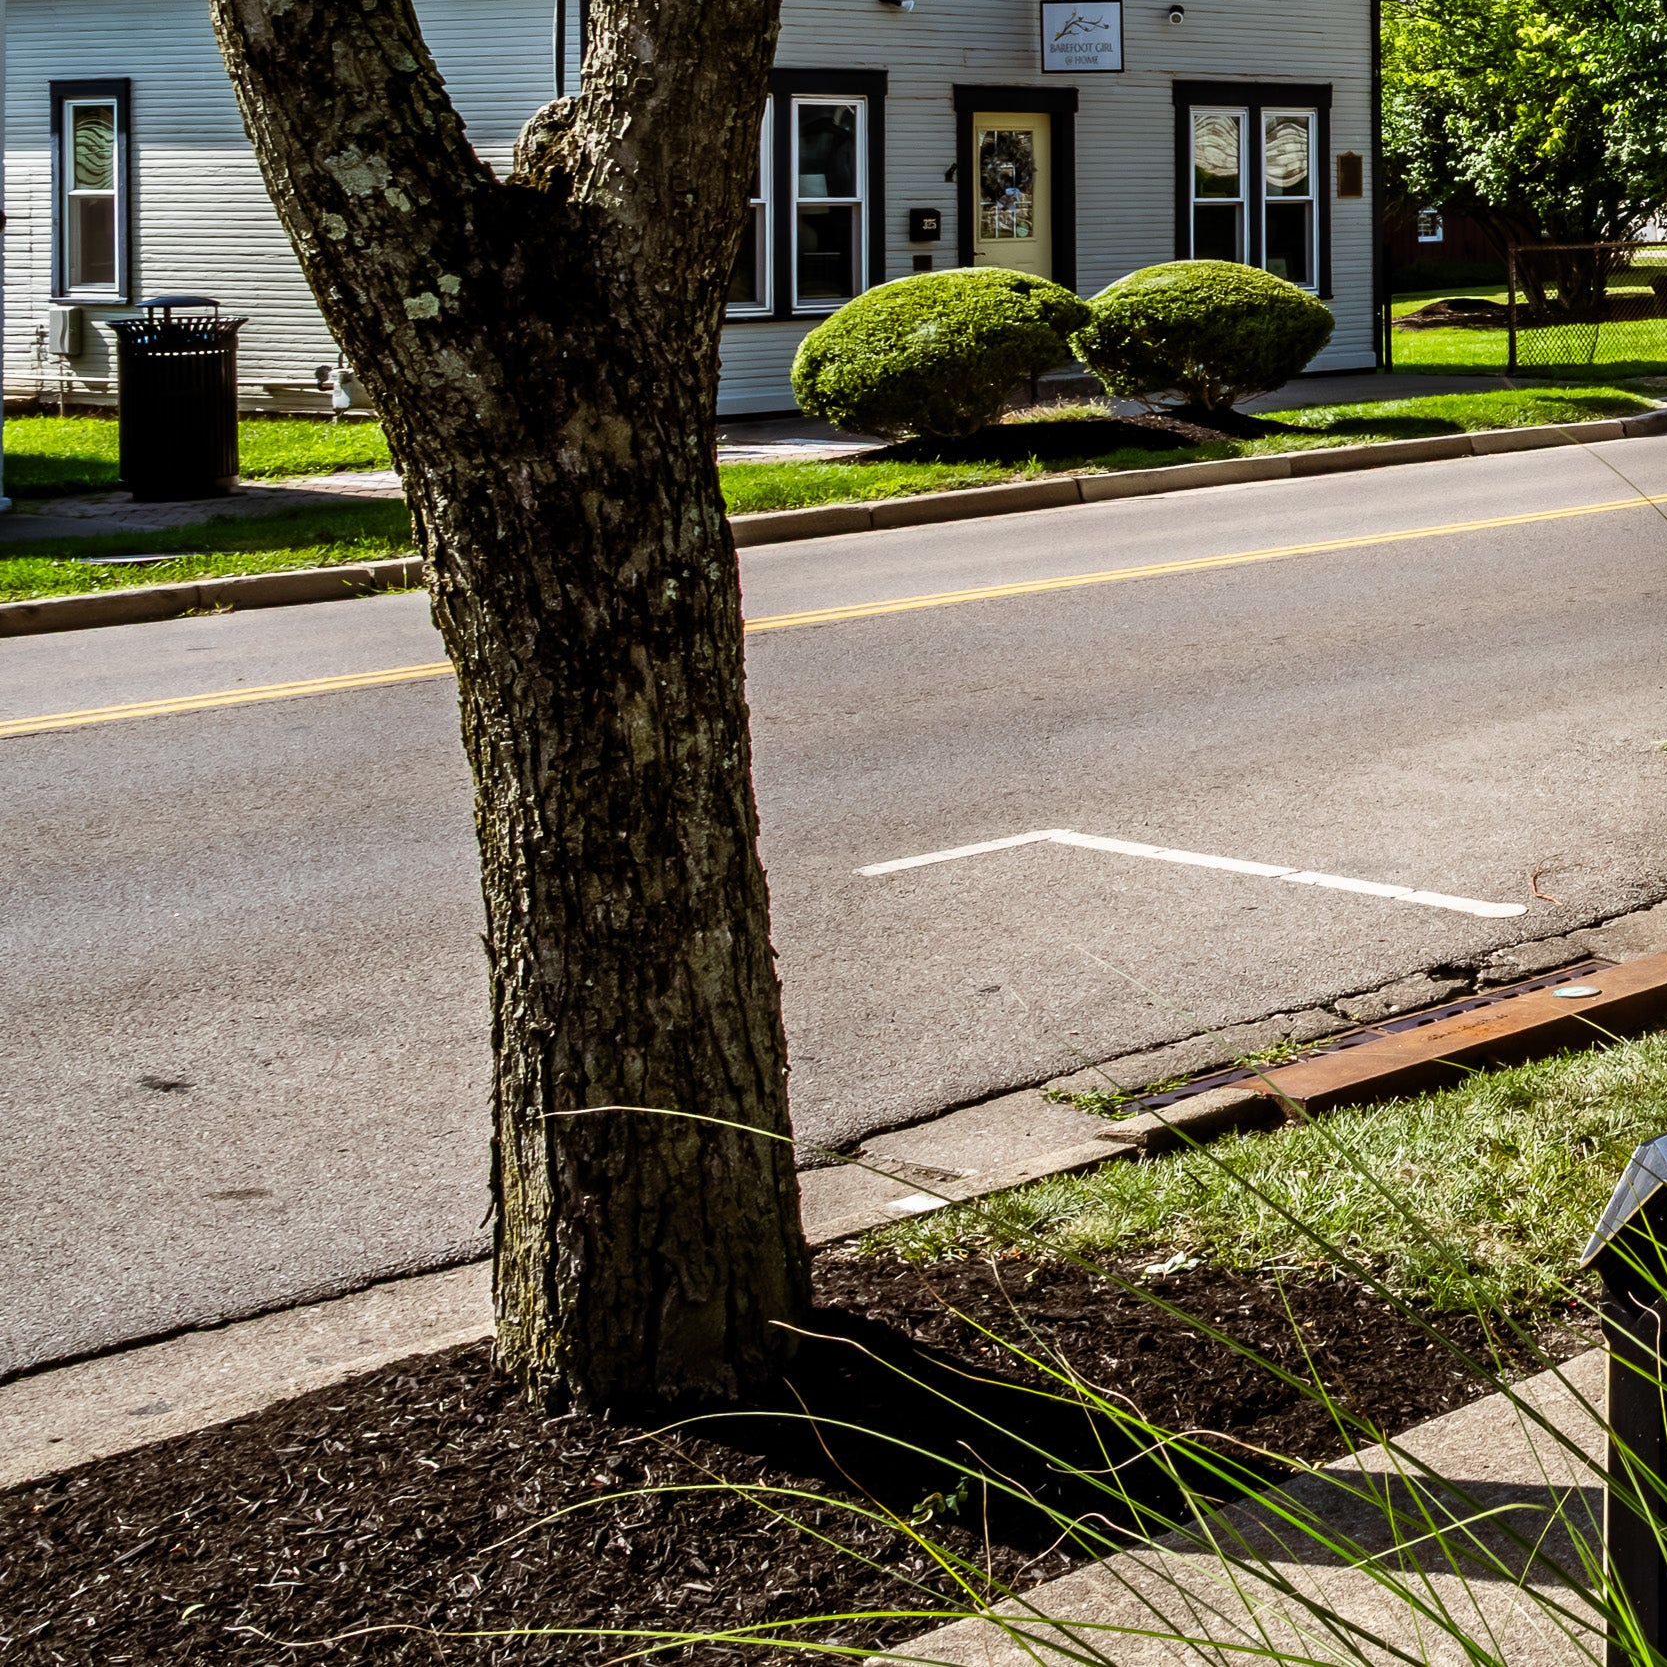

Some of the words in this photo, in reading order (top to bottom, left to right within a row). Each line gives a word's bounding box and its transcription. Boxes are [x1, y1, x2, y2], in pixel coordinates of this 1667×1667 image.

[1049, 42, 1093, 53] BAREFOOT
[1095, 42, 1114, 53] GIRL
[1074, 55, 1099, 65] HOME
